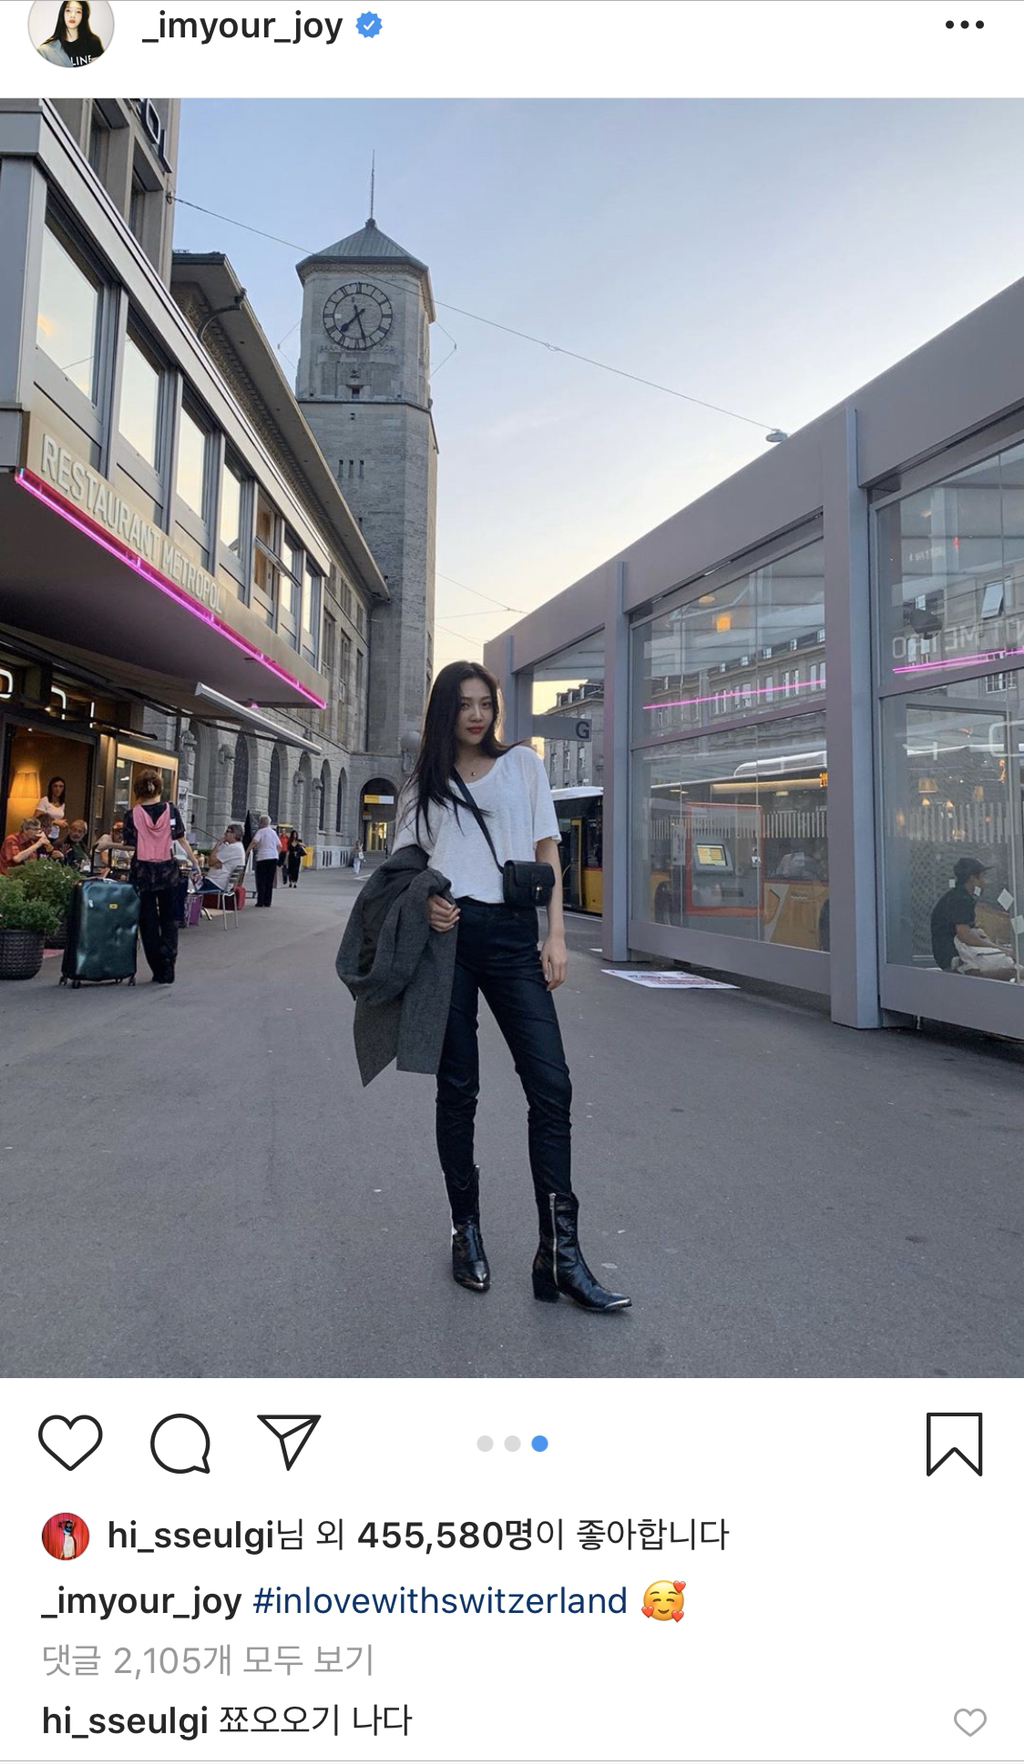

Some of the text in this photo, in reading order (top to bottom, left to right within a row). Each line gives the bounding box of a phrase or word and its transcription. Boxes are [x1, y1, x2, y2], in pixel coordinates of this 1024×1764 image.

[41, 434, 222, 614] RESTAURANT METROPOL
[575, 720, 590, 739] G
